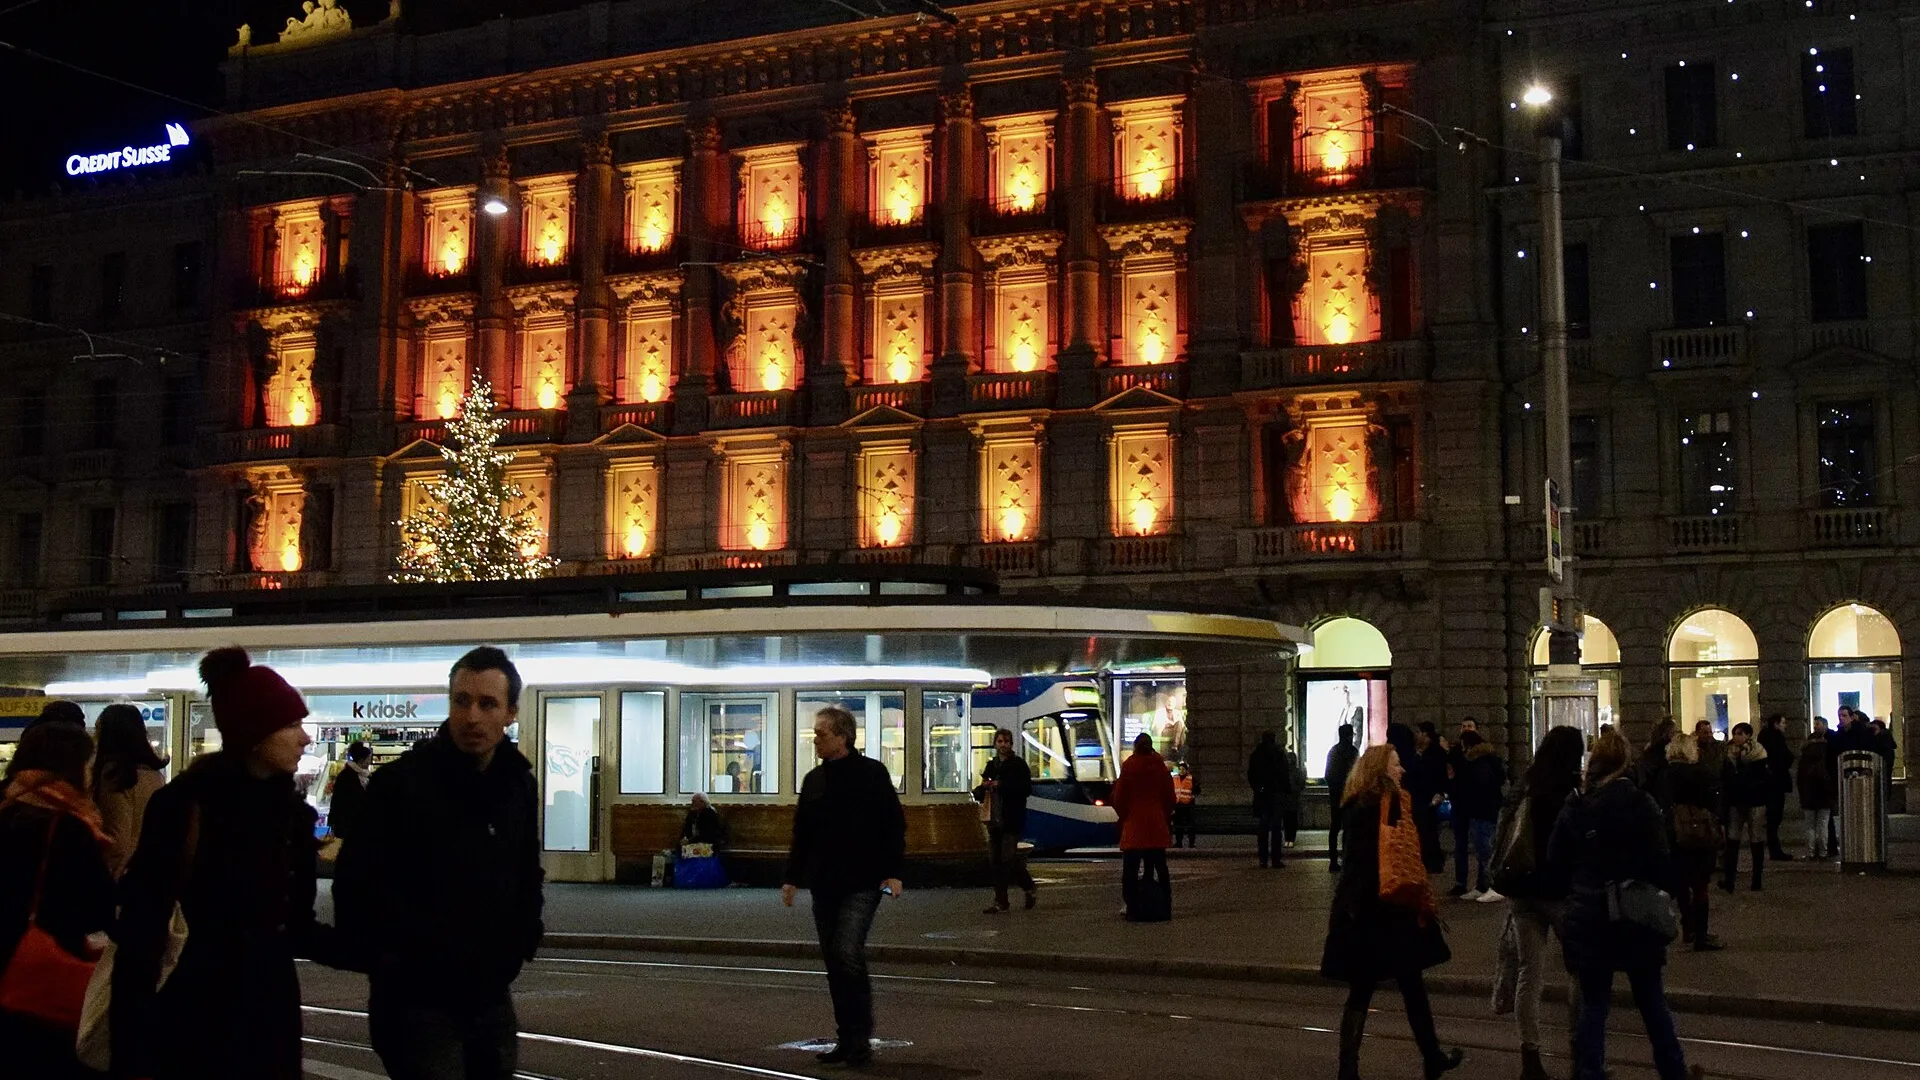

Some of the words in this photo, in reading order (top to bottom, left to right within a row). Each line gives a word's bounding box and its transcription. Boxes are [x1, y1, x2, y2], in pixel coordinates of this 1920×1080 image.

[66, 152, 122, 175] CREDIT
[122, 144, 171, 167] SUISSE
[353, 701, 364, 718] k
[367, 699, 418, 718] kiosk
